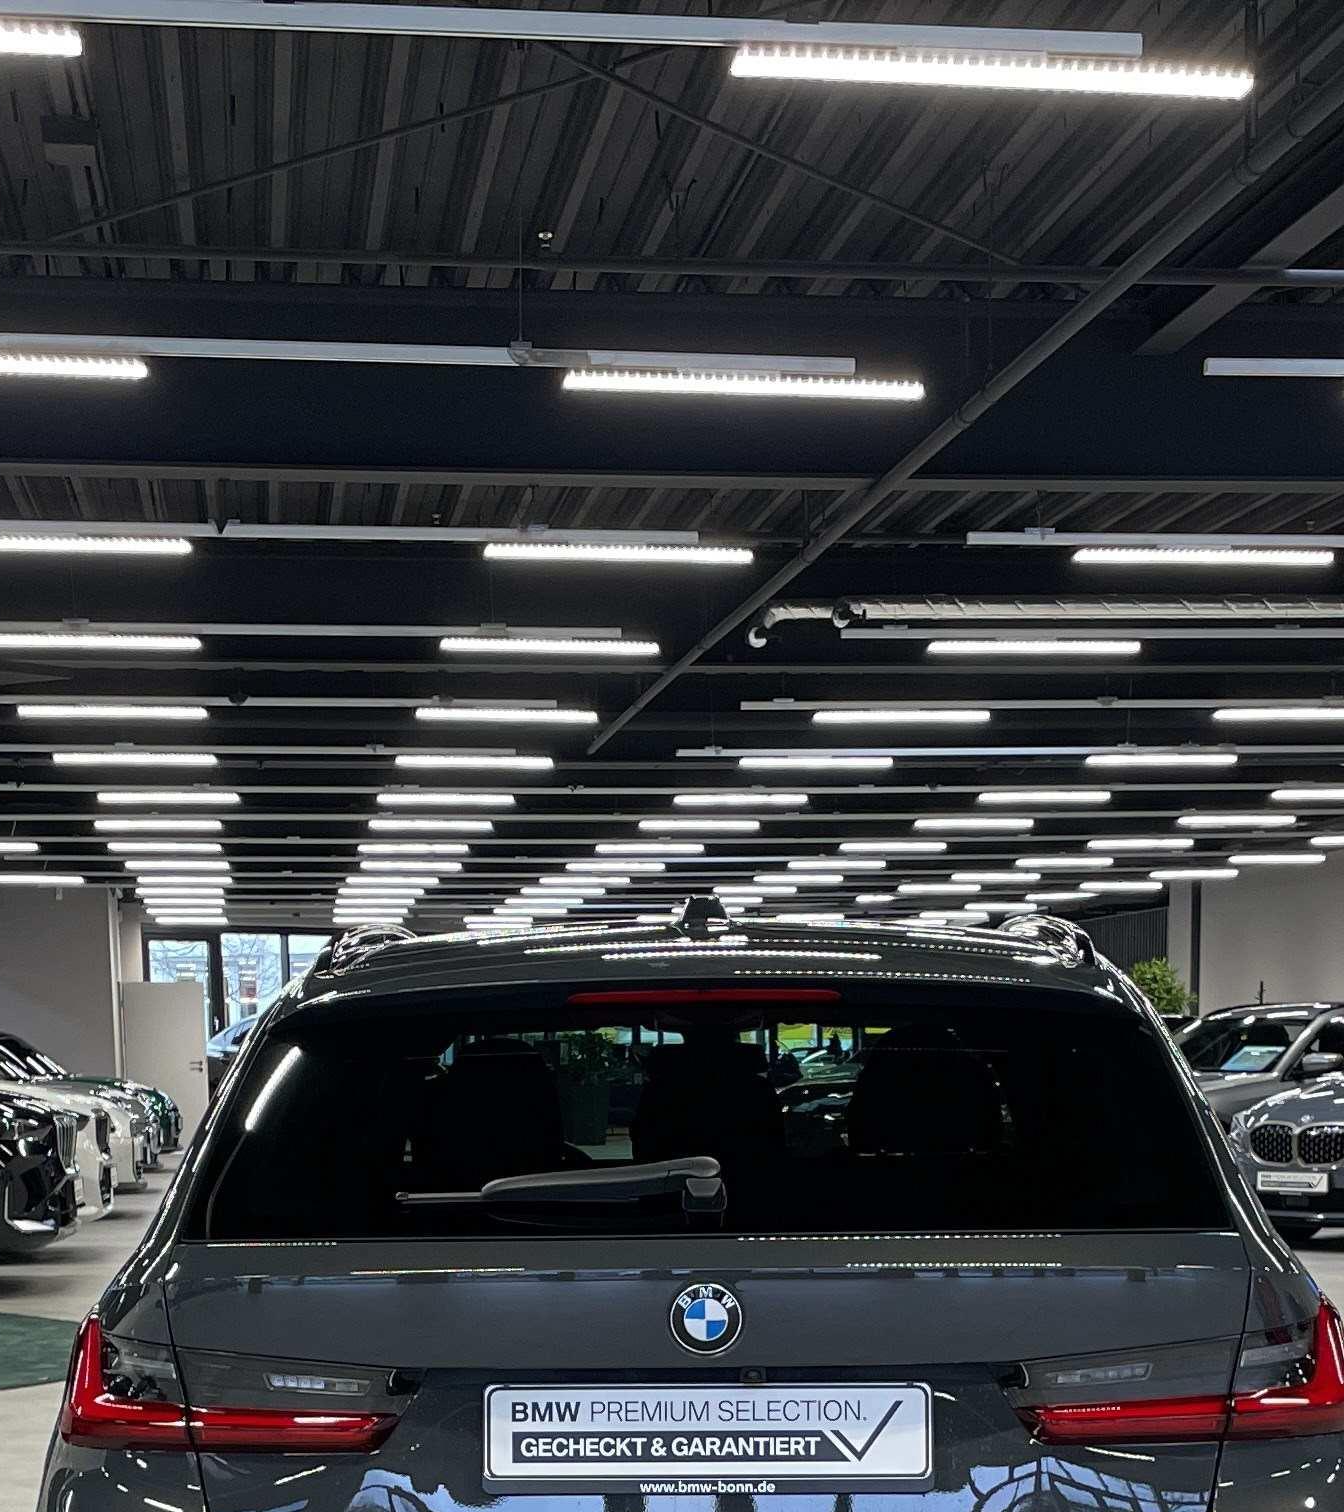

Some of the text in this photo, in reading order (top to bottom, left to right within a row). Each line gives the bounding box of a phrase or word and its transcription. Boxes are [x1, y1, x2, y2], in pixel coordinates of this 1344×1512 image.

[677, 1286, 736, 1309] BMW
[511, 1399, 868, 1423] BMW PREMIUM SELECTION.
[520, 1436, 821, 1457] GECHECKT & GARANTIERT
[639, 1480, 776, 1493] www.bmw-bonn.de
